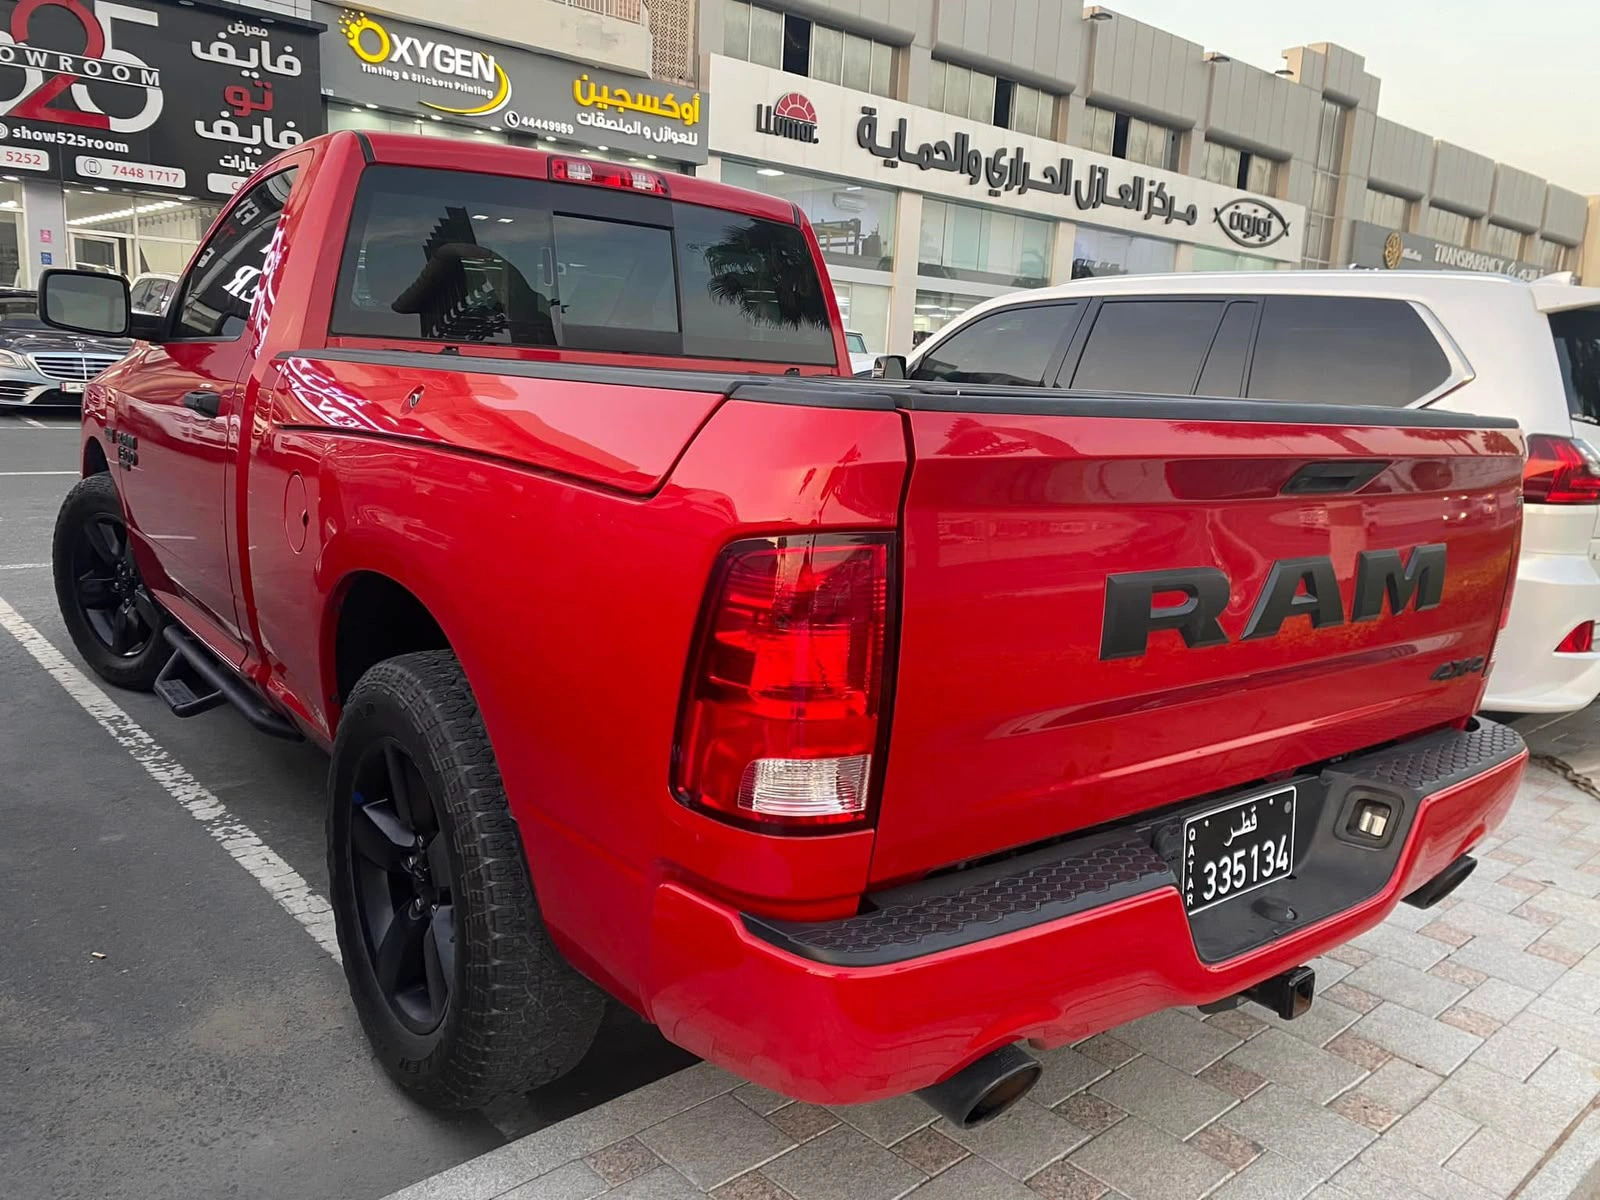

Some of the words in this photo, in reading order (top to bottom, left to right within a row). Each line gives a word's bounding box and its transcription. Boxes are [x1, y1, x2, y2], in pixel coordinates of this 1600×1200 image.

[227, 20, 268, 37] معرض
[191, 31, 302, 77] فايف
[345, 17, 496, 83] OXYGEN
[224, 80, 273, 117] تو
[361, 63, 400, 81] Tinting
[401, 71, 409, 80] &
[411, 73, 453, 89] Stickers
[454, 82, 494, 100] Printing
[572, 74, 701, 126] أوكسجين
[12, 126, 130, 154] show525room
[194, 110, 304, 155] فايف
[576, 111, 642, 136] الملصقات
[642, 126, 651, 140] و
[652, 125, 698, 146] للعوازل
[5, 152, 42, 166] 5252
[219, 154, 264, 174] يارات
[857, 106, 983, 186] والحماية
[112, 164, 145, 180] 7448
[149, 169, 180, 184] 1717
[985, 146, 1073, 197] الحراري
[1074, 164, 1146, 211] العازل
[1145, 179, 1198, 226] مركز
[1228, 204, 1274, 243] أوزون
[1098, 543, 1448, 661] RAM
[1223, 805, 1258, 847] قطر
[1186, 827, 1197, 907] QATAR
[1202, 834, 1289, 901] 335134
